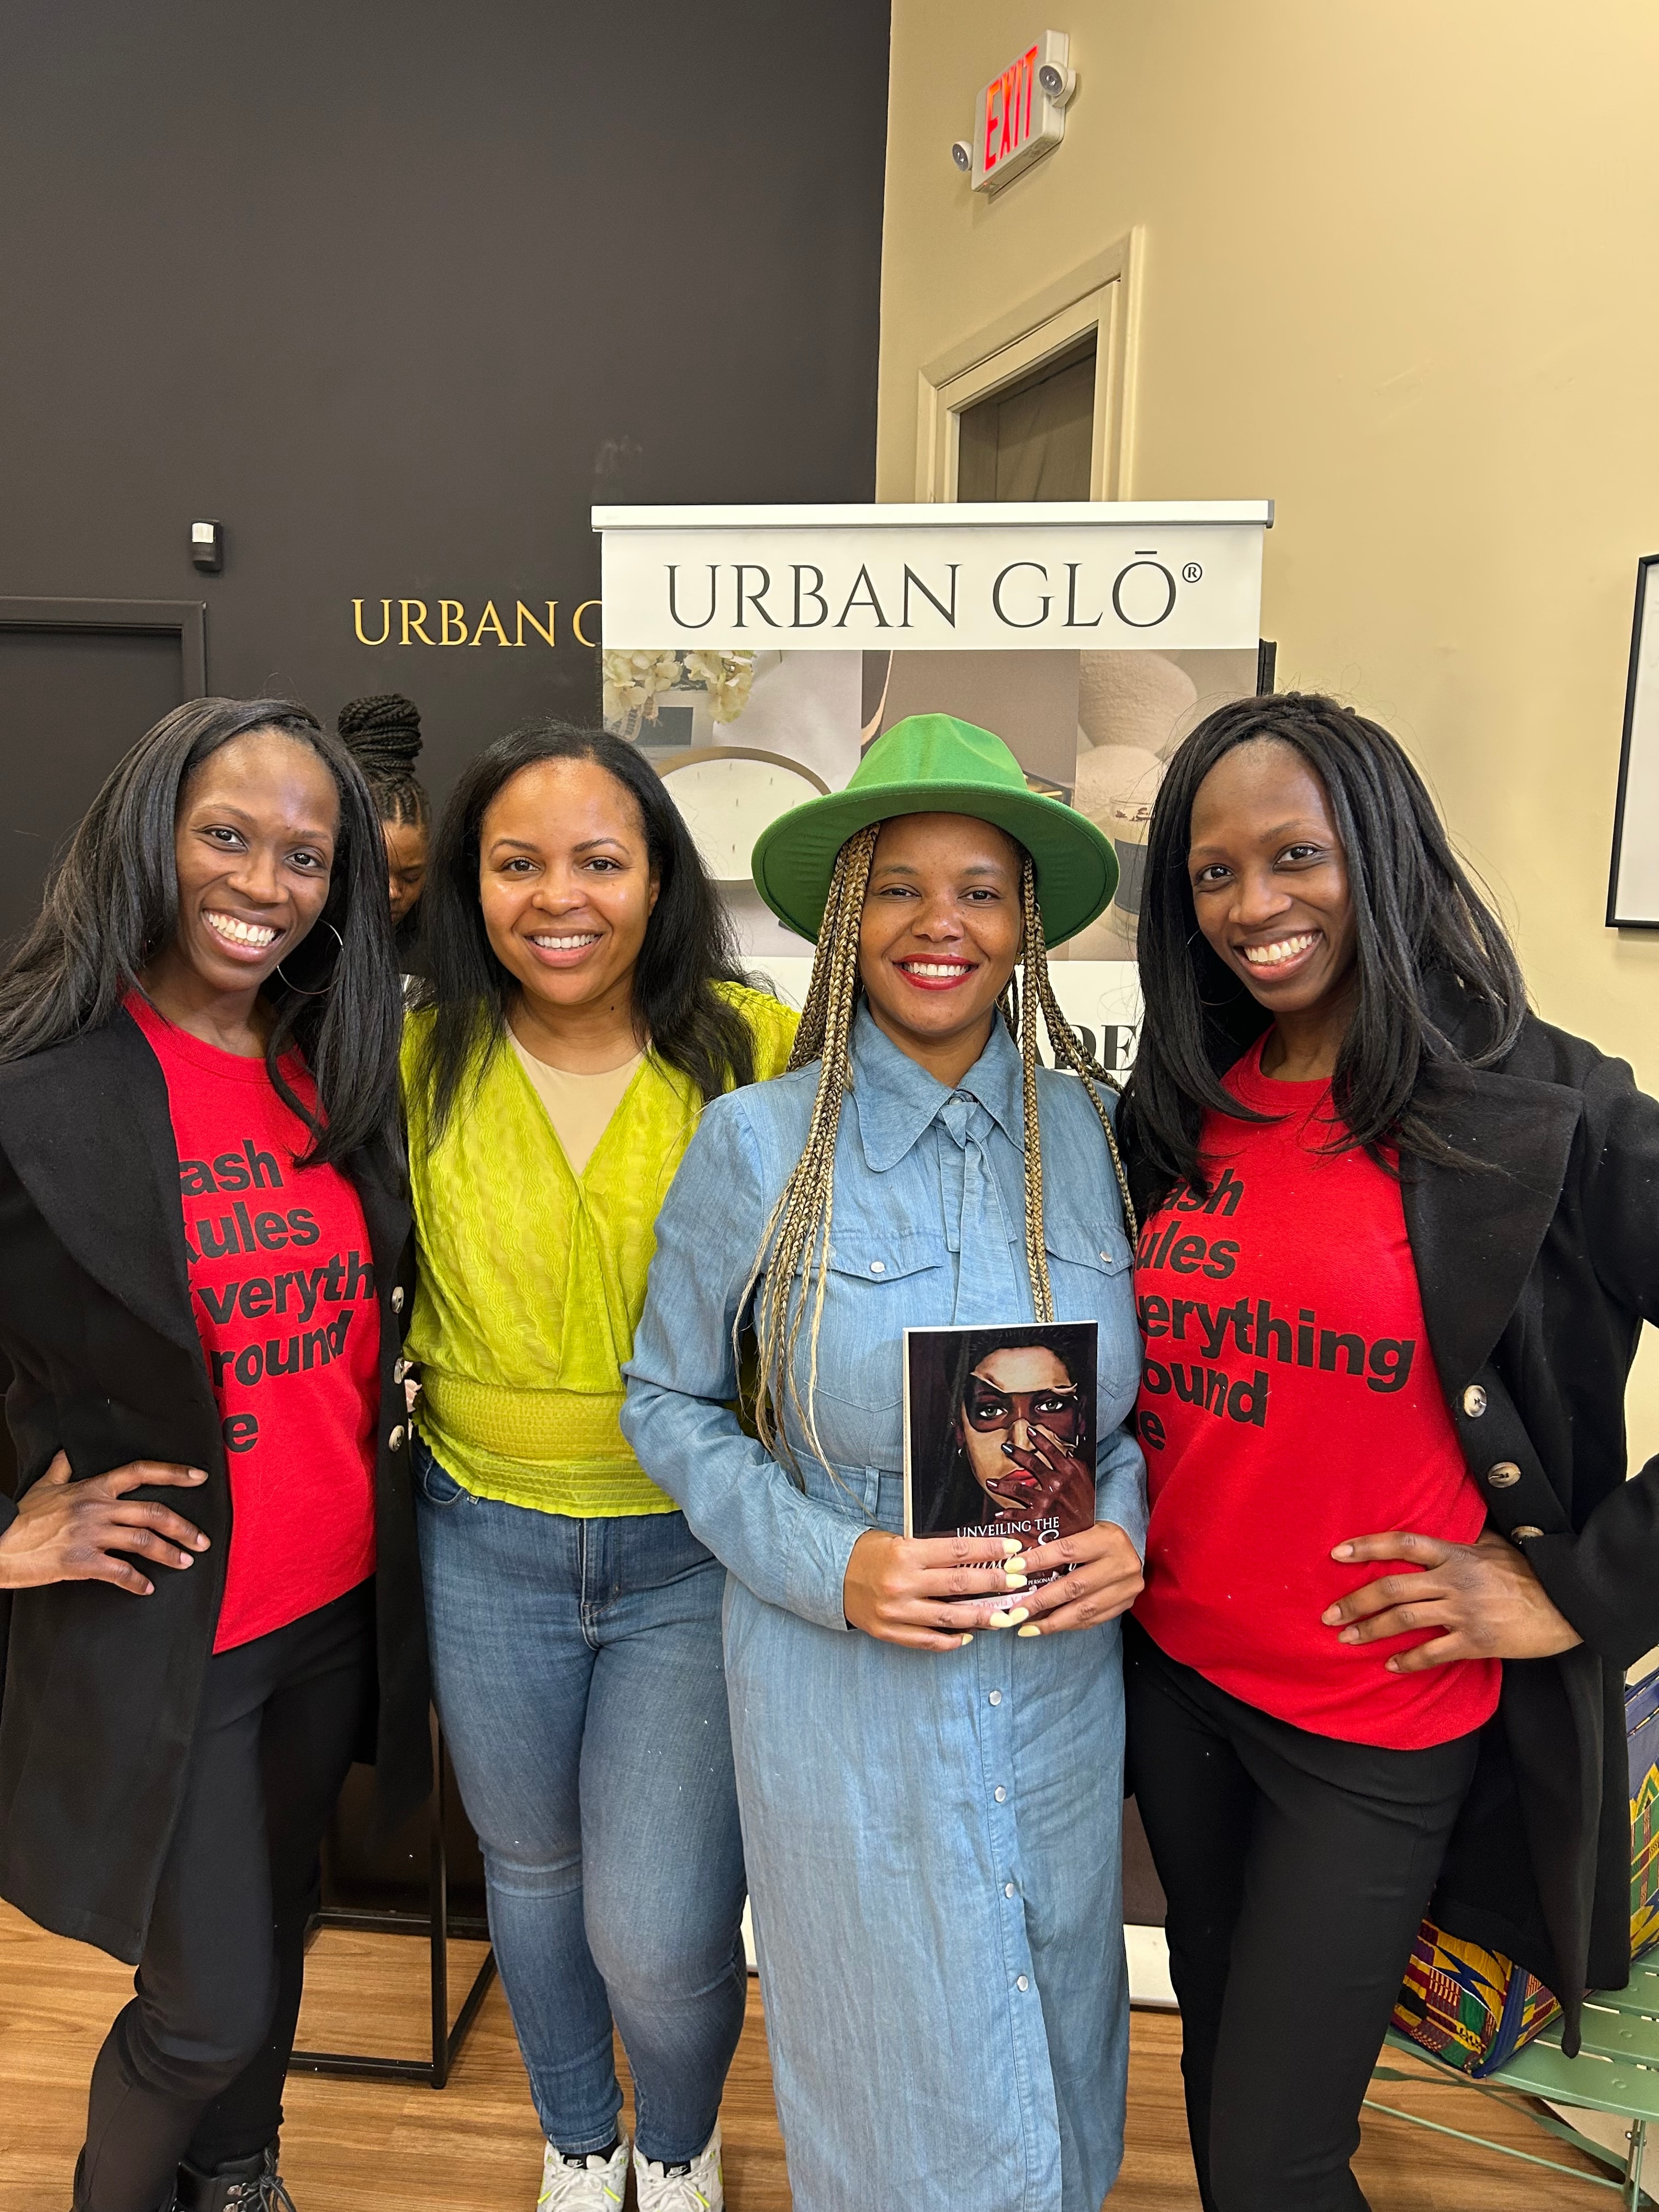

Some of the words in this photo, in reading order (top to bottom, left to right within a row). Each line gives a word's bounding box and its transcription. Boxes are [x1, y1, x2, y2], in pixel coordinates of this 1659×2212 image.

[983, 44, 1039, 173] EXIT
[350, 599, 559, 648] URBAN
[664, 563, 963, 629] URBAN
[185, 1201, 320, 1264] ules
[189, 1251, 374, 1324] veryth
[209, 1309, 353, 1388] round
[222, 1414, 259, 1453] e
[1139, 1410, 1166, 1451] e
[956, 1520, 1032, 1538] UNVEILING
[1035, 1516, 1060, 1531] THE
